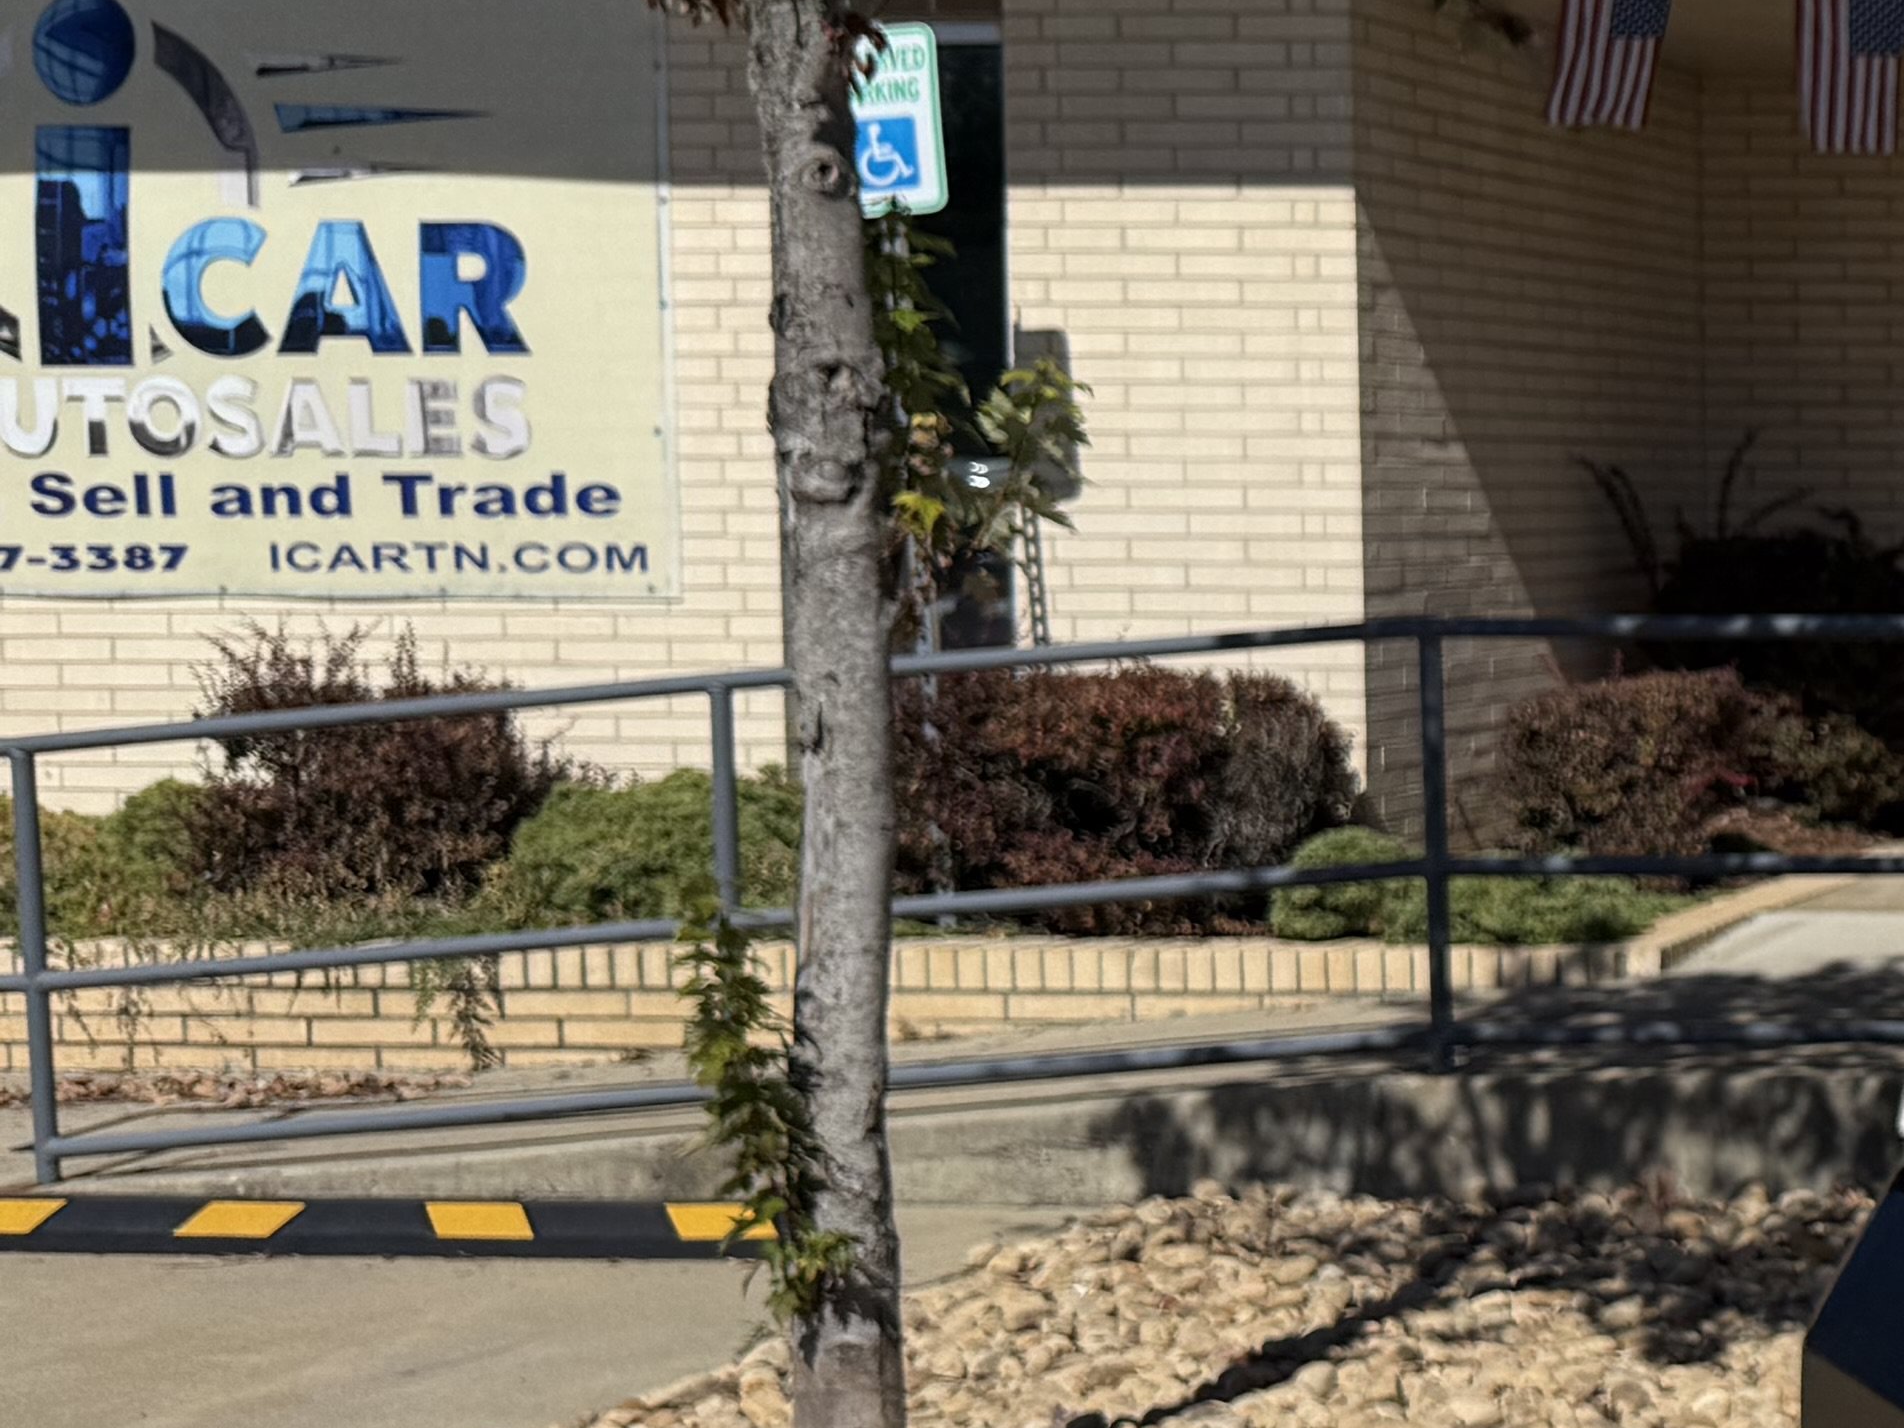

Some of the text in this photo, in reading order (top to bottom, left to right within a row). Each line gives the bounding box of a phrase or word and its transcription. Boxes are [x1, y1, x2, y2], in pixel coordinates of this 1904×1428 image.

[29, 472, 623, 518] Sell and Trade
[269, 542, 649, 574] ICARTN.COM
